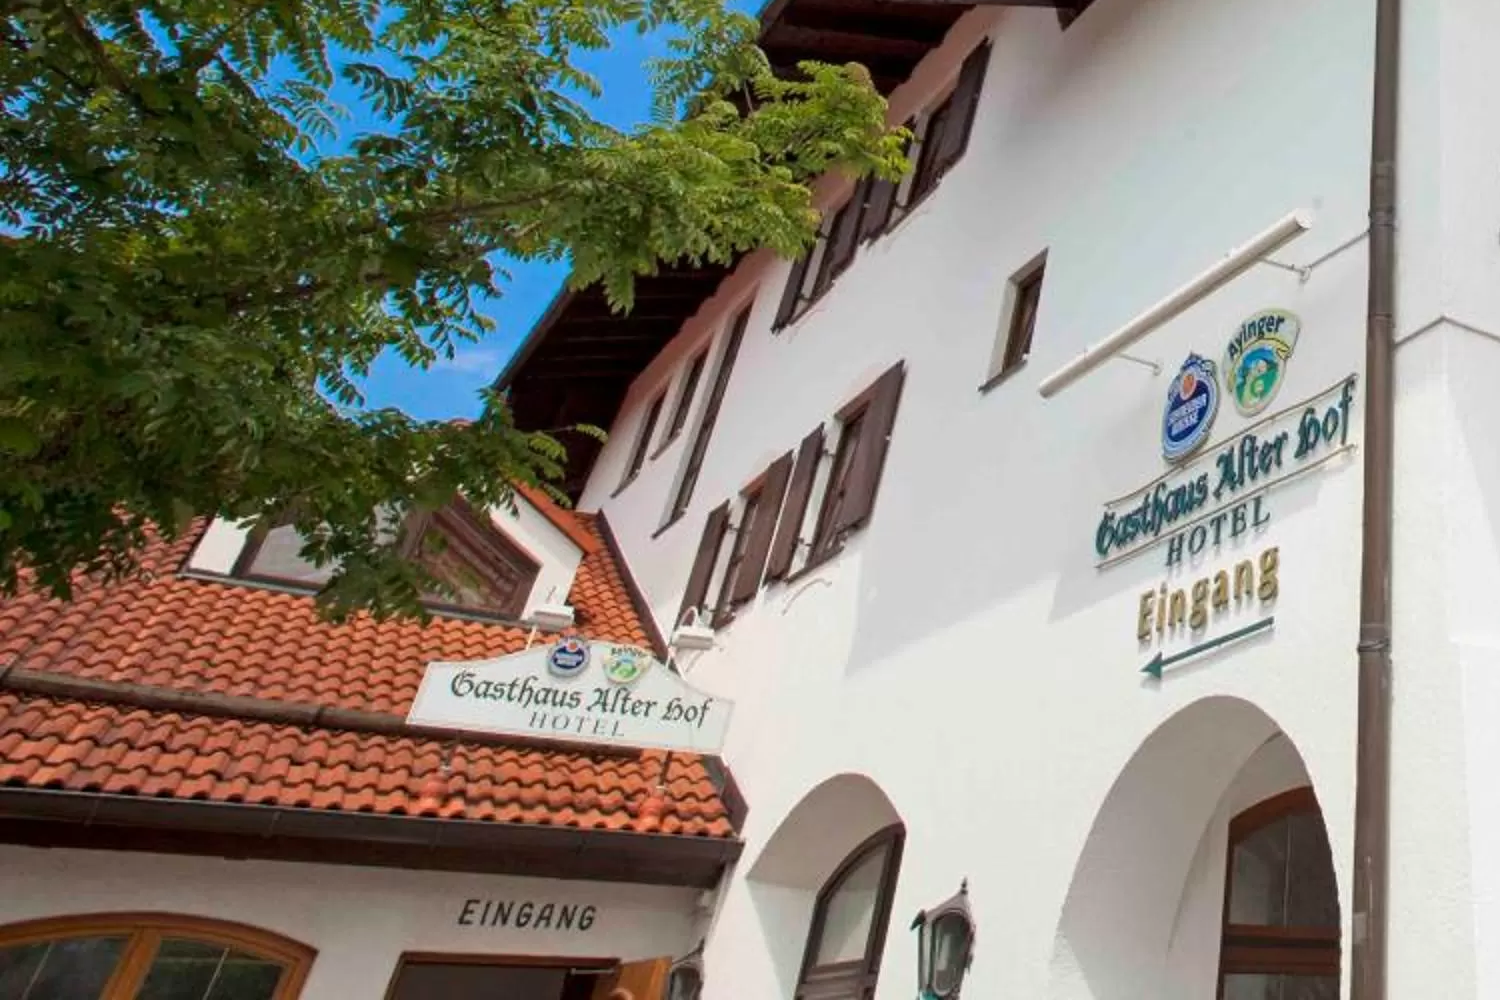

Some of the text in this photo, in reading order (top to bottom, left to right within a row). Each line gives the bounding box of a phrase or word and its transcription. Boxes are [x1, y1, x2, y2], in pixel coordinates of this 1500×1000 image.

[1096, 378, 1356, 556] Gasthaus Alter Hof
[1165, 496, 1271, 567] HOTEL
[1137, 546, 1280, 641] Eingang
[451, 668, 713, 728] Gasthaus Alter Hof
[528, 711, 625, 737] HOTEL
[458, 898, 597, 931] EINGANG
